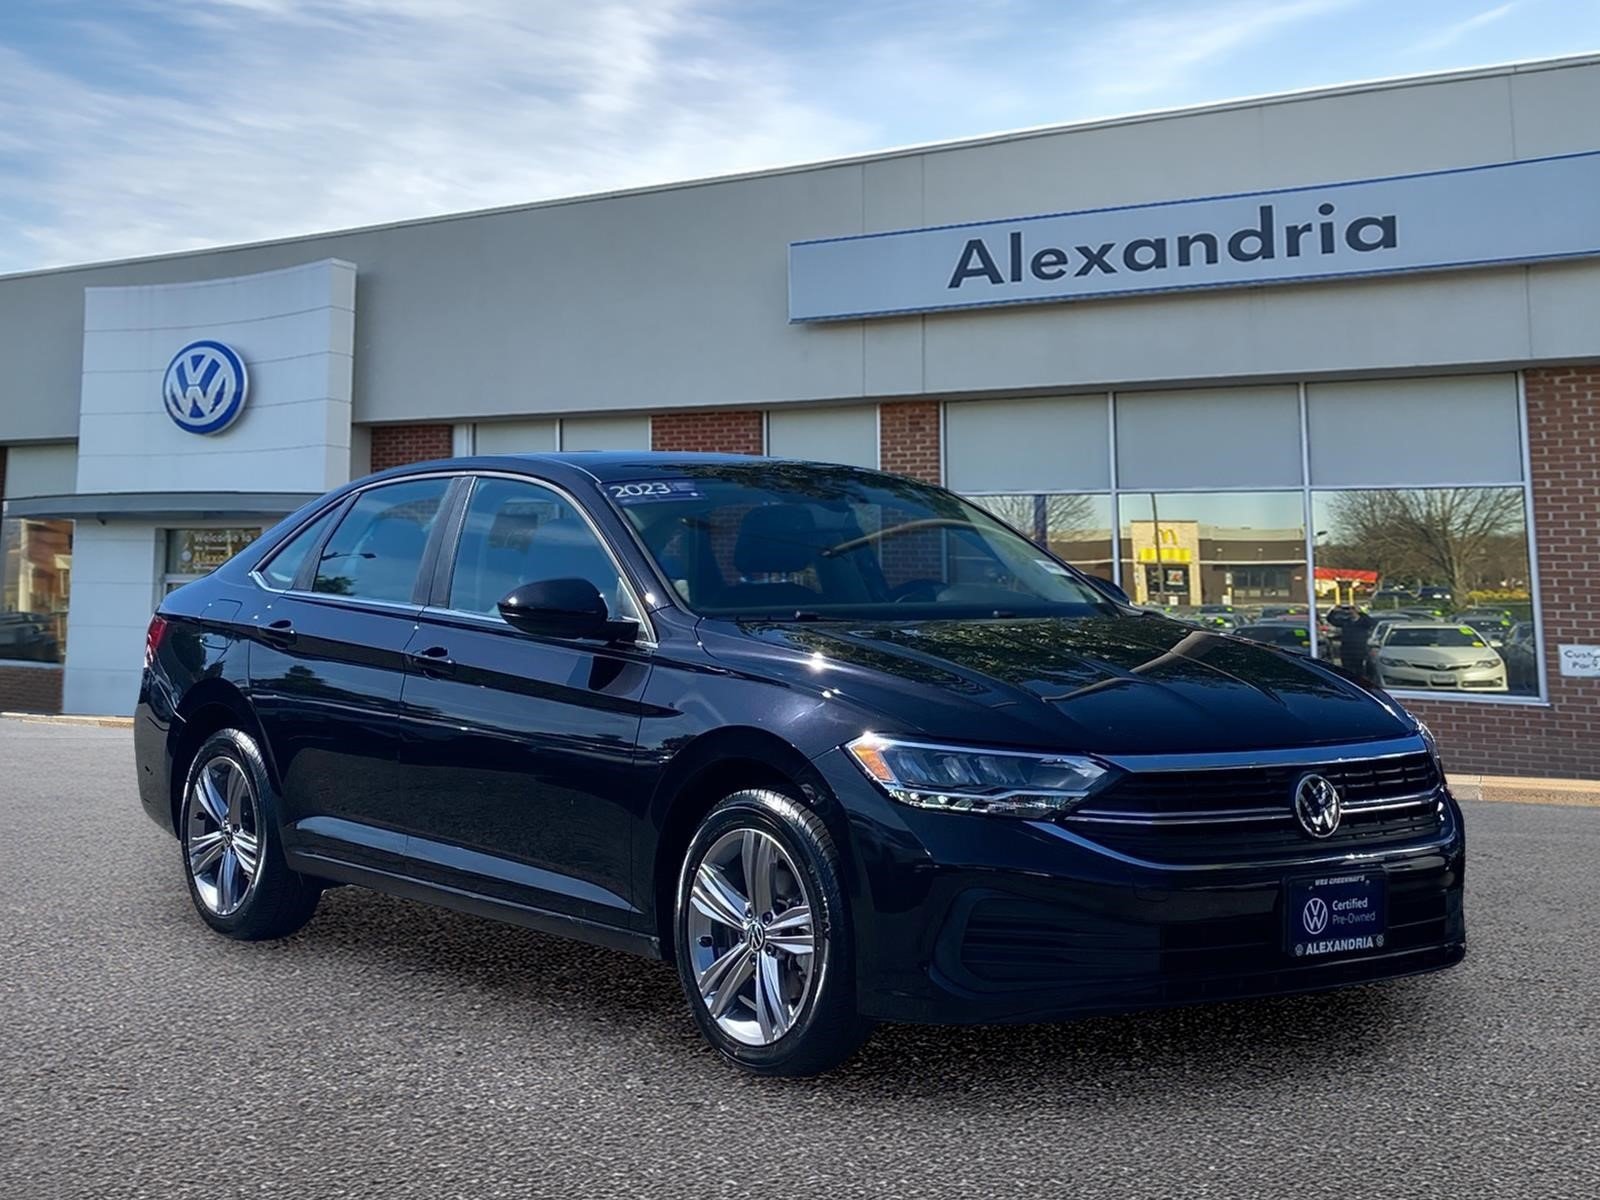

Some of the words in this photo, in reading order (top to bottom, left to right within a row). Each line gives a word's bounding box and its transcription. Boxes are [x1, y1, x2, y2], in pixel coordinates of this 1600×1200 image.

[947, 203, 1399, 288] Alexandria
[163, 341, 246, 433] VW
[609, 482, 672, 498] 2023
[1332, 897, 1369, 911] Certified
[1332, 911, 1376, 925] Pre-Owned
[1305, 936, 1374, 956] ALEXANDRIA
